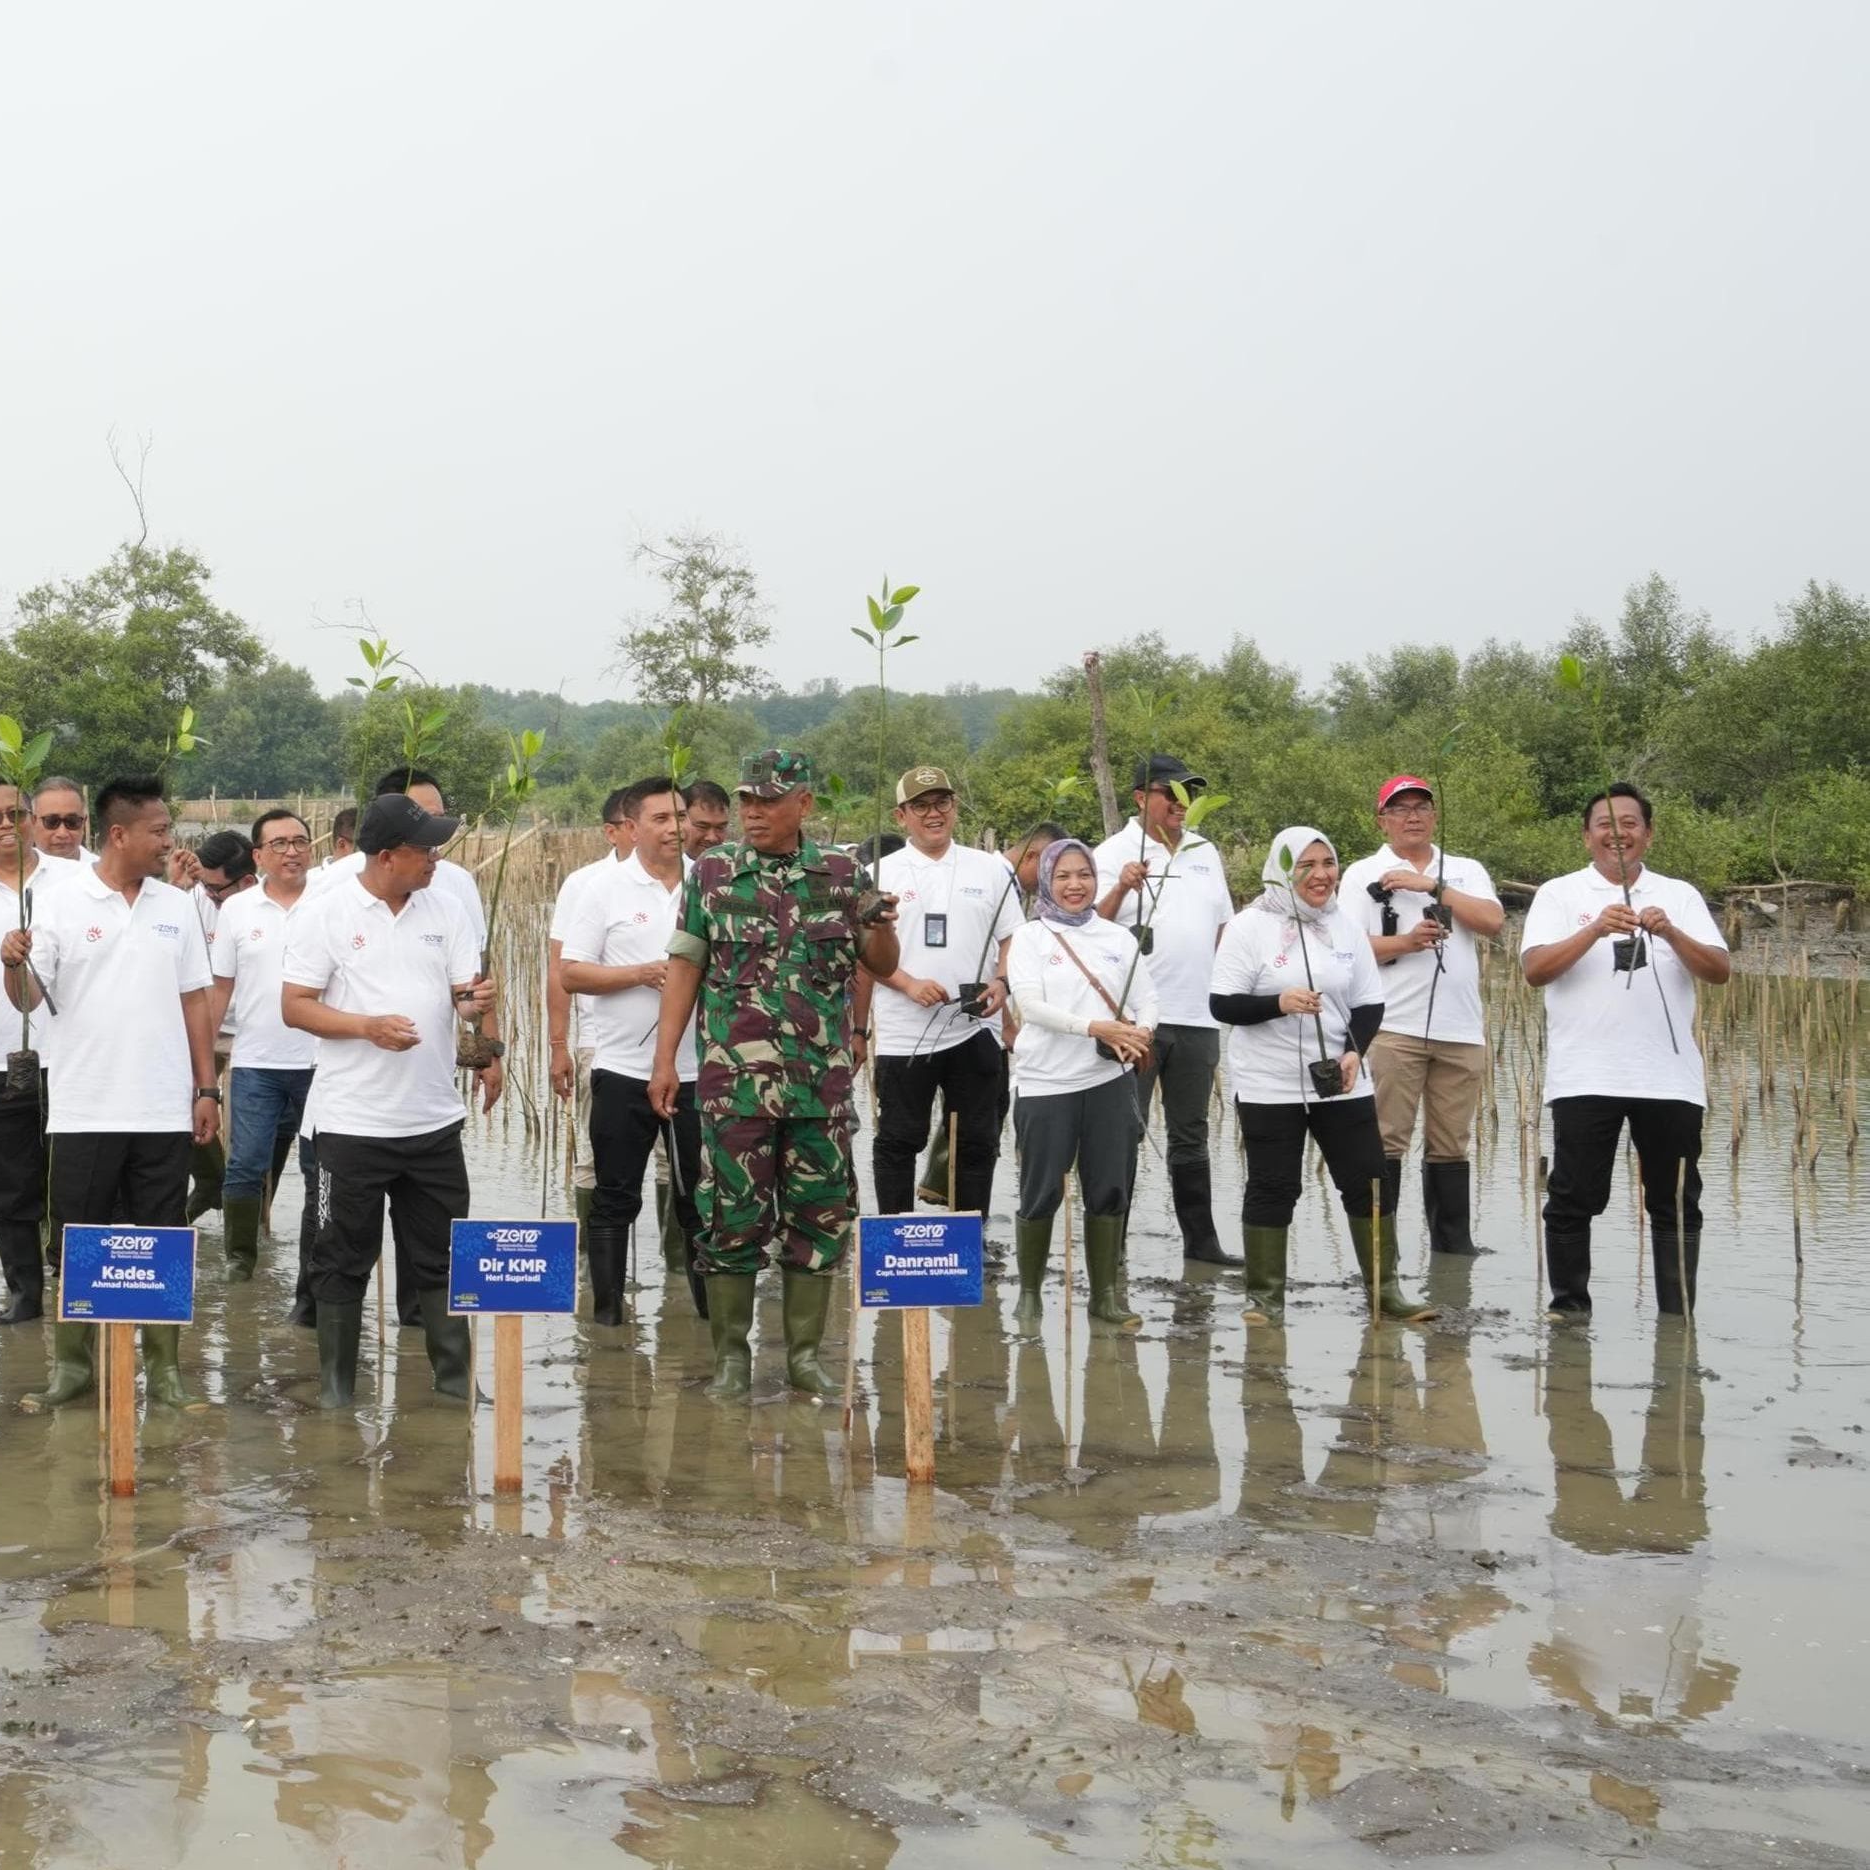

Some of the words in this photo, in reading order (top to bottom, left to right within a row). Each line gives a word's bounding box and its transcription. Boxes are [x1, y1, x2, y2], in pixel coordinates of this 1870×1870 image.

[479, 1258, 505, 1272] Dir
[508, 1259, 547, 1273] KMR
[885, 1253, 958, 1268] Danramil
[102, 1265, 155, 1281] Kades
[485, 1273, 504, 1282] Heri
[505, 1274, 541, 1283] Supriadi
[91, 1281, 121, 1289] Ahmad
